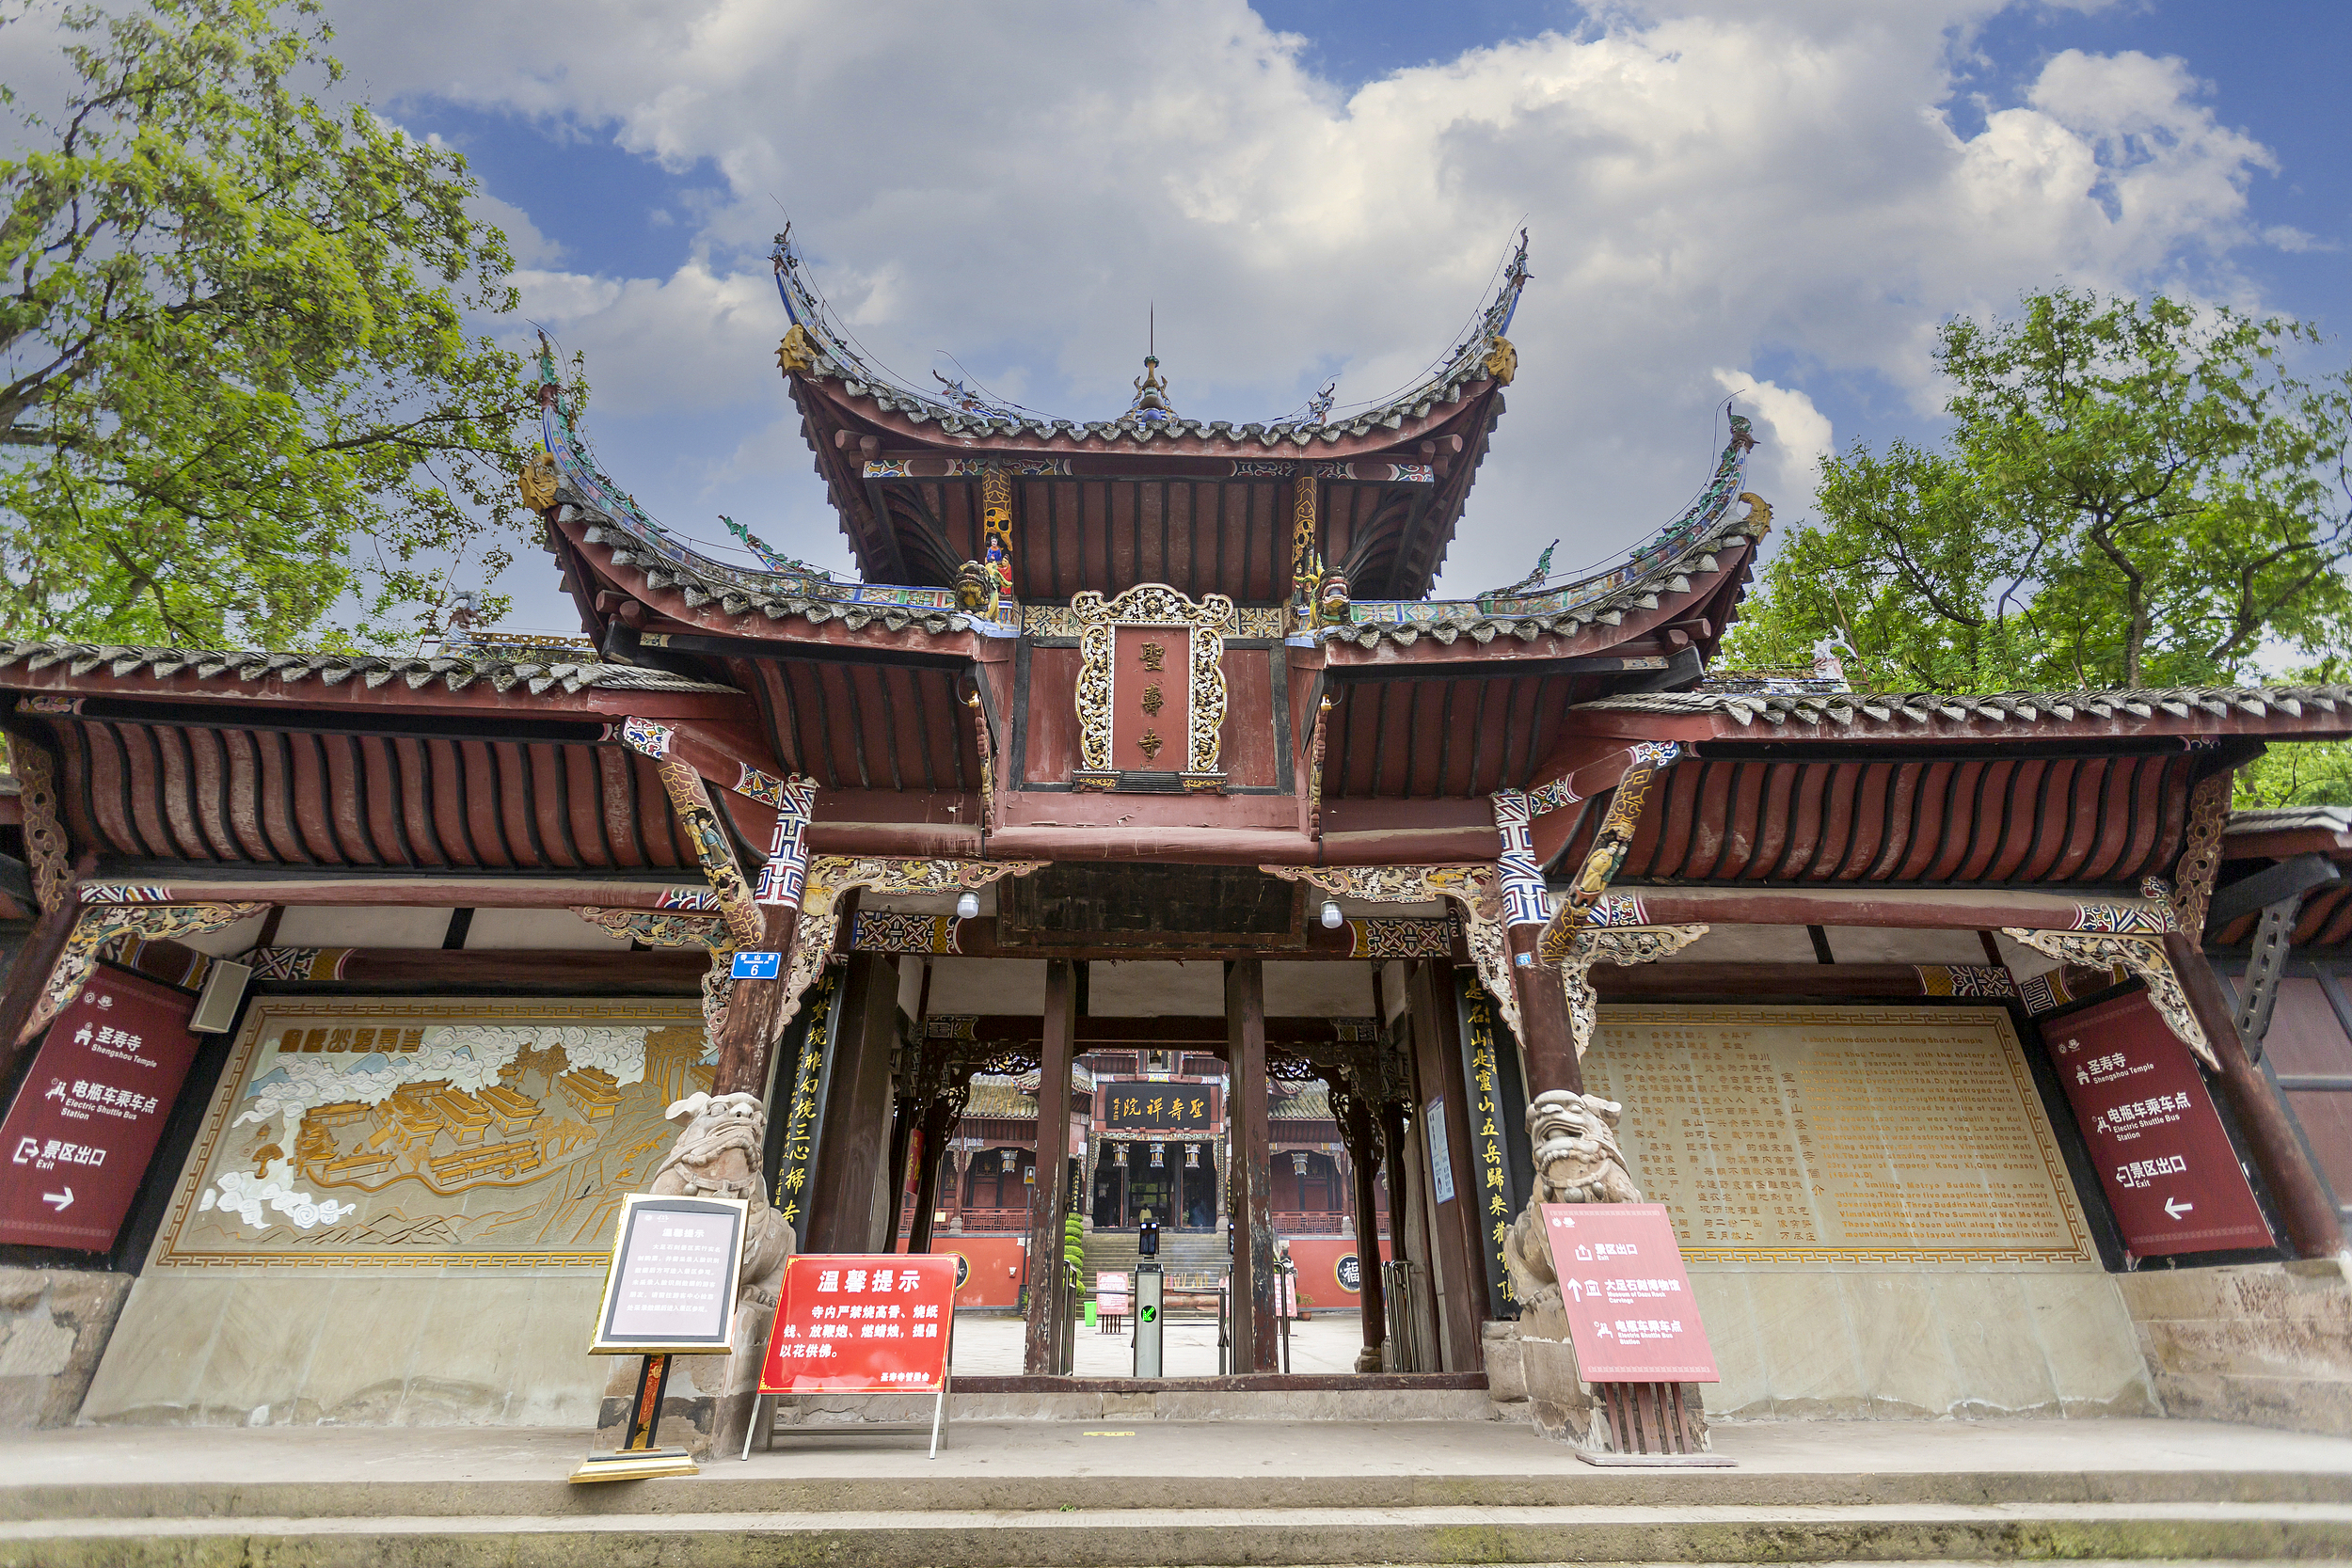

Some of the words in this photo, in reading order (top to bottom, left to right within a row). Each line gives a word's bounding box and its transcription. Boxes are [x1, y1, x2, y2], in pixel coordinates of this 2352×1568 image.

[1138, 641, 1166, 760] 聖壽寺
[751, 964, 759, 976] 6
[95, 1025, 142, 1052] 圣寿寺
[91, 1044, 133, 1062] Shengshou
[134, 1053, 158, 1069] Temple
[2087, 1052, 2126, 1076] 圣寿寺
[2093, 1069, 2128, 1085] Shengshou
[2129, 1061, 2154, 1076] Temple
[72, 1080, 158, 1114] 电瓶车乘车点
[61, 1108, 89, 1121] Station
[65, 1098, 96, 1112] Electric
[96, 1104, 122, 1117] Shuttle
[123, 1110, 137, 1120] Bus
[2107, 1092, 2191, 1124] 电瓶车乘车点
[2113, 1121, 2138, 1133] Electric
[2139, 1116, 2164, 1129] Shuttle
[2165, 1113, 2180, 1123] Bus
[2117, 1131, 2141, 1142] Station
[41, 1140, 107, 1166] 景区出口
[1834, 1142, 1854, 1151] Ming
[1918, 1143, 1935, 1151] only
[1888, 1152, 1926, 1161] standing
[36, 1159, 55, 1170] Exit
[1852, 1163, 1871, 1171] year
[1893, 1163, 1929, 1171] emperor
[1936, 1162, 1958, 1171] Kang
[2004, 1162, 2037, 1171] dynasty
[2130, 1155, 2186, 1179] 景区出口
[2135, 1179, 2151, 1189] Exit
[1923, 1191, 1939, 1199] five
[2017, 1191, 2047, 1200] namely
[1837, 1200, 1883, 1210] Sovereign
[1884, 1200, 1902, 1209] Hall
[2031, 1201, 2053, 1211] Hall,
[1842, 1220, 1869, 1228] These
[1874, 1220, 1896, 1228] halls
[1899, 1220, 1915, 1228] had
[1919, 1220, 1941, 1228] been
[1946, 1220, 1965, 1228] built
[1971, 1220, 1994, 1229] along
[1998, 1220, 2012, 1228] the
[662, 1228, 706, 1239] 温馨提示
[1927, 1230, 1955, 1240] layout
[1984, 1230, 2019, 1239] rational
[1595, 1243, 1638, 1256] 景区出口
[1343, 1261, 1359, 1283] 福
[817, 1269, 921, 1293] 温馨提示
[1604, 1278, 1681, 1292] 大足石刻博物馆
[811, 1305, 939, 1319] 寺内严禁烧高香、烧纸
[1615, 1321, 1683, 1334] 电瓶车乘车点
[779, 1344, 837, 1358] 以花供佛。
